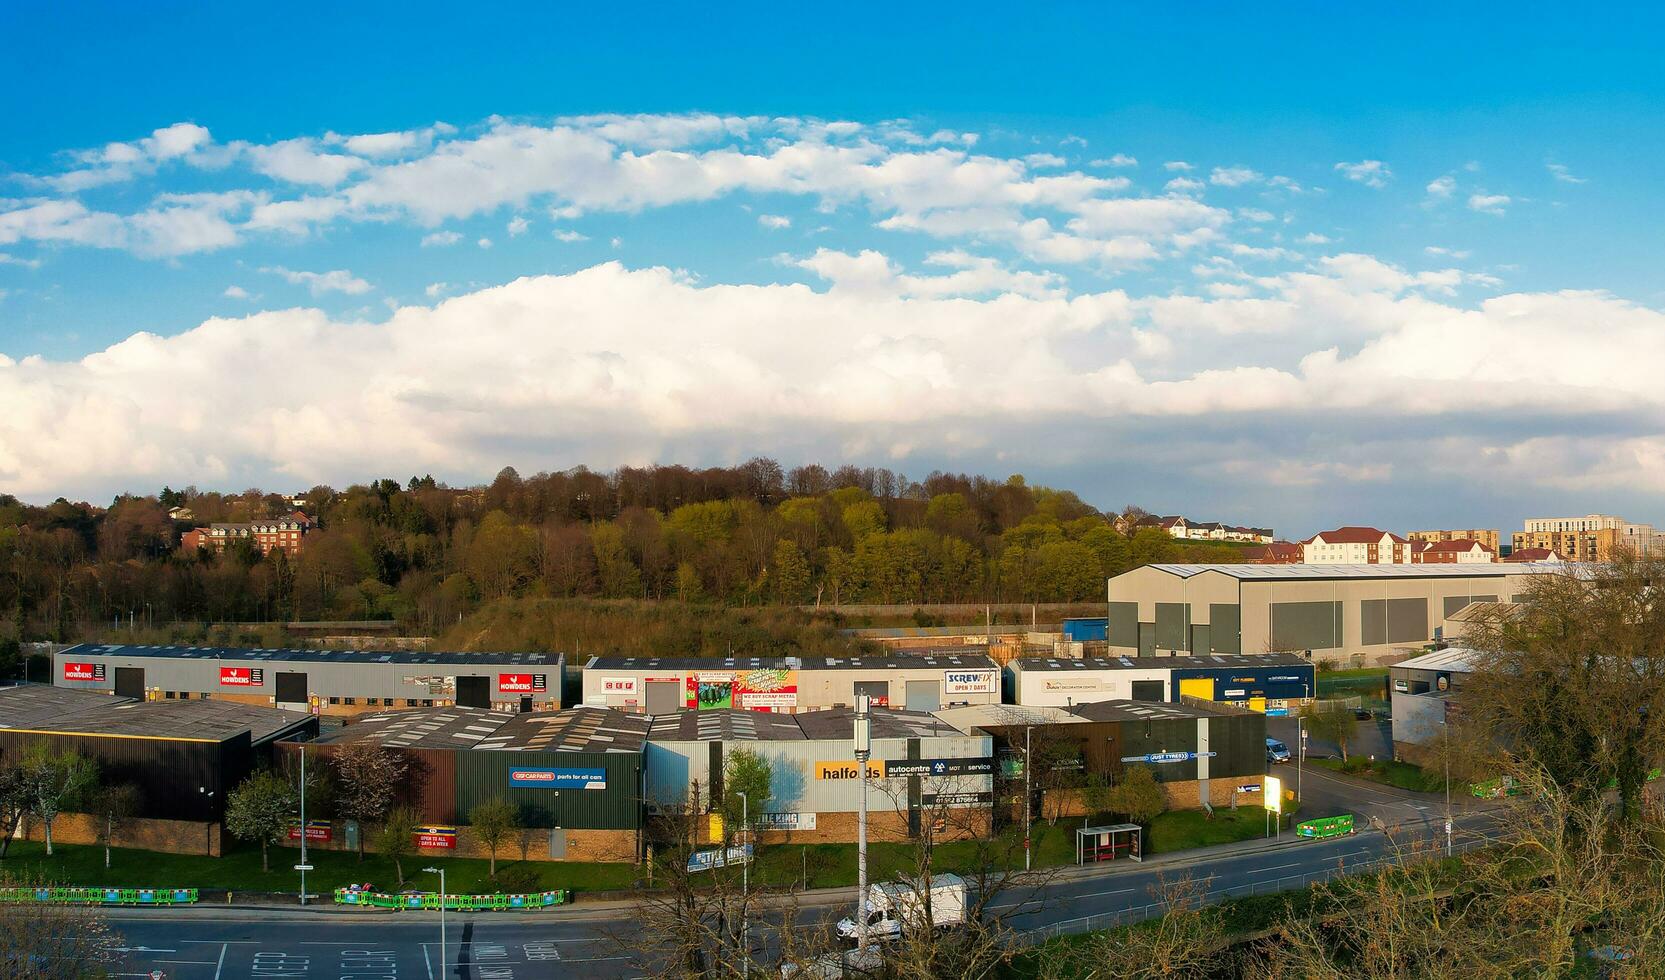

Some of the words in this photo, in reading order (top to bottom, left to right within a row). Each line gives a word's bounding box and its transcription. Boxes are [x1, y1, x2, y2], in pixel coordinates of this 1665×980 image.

[66, 671, 92, 679] HOWDENS
[949, 674, 993, 683] SCREWFIX
[222, 676, 249, 684] HOWDENS
[888, 765, 930, 773] autocentre
[968, 763, 991, 771] service
[823, 767, 880, 779] halfods
[251, 952, 310, 977] KEEP
